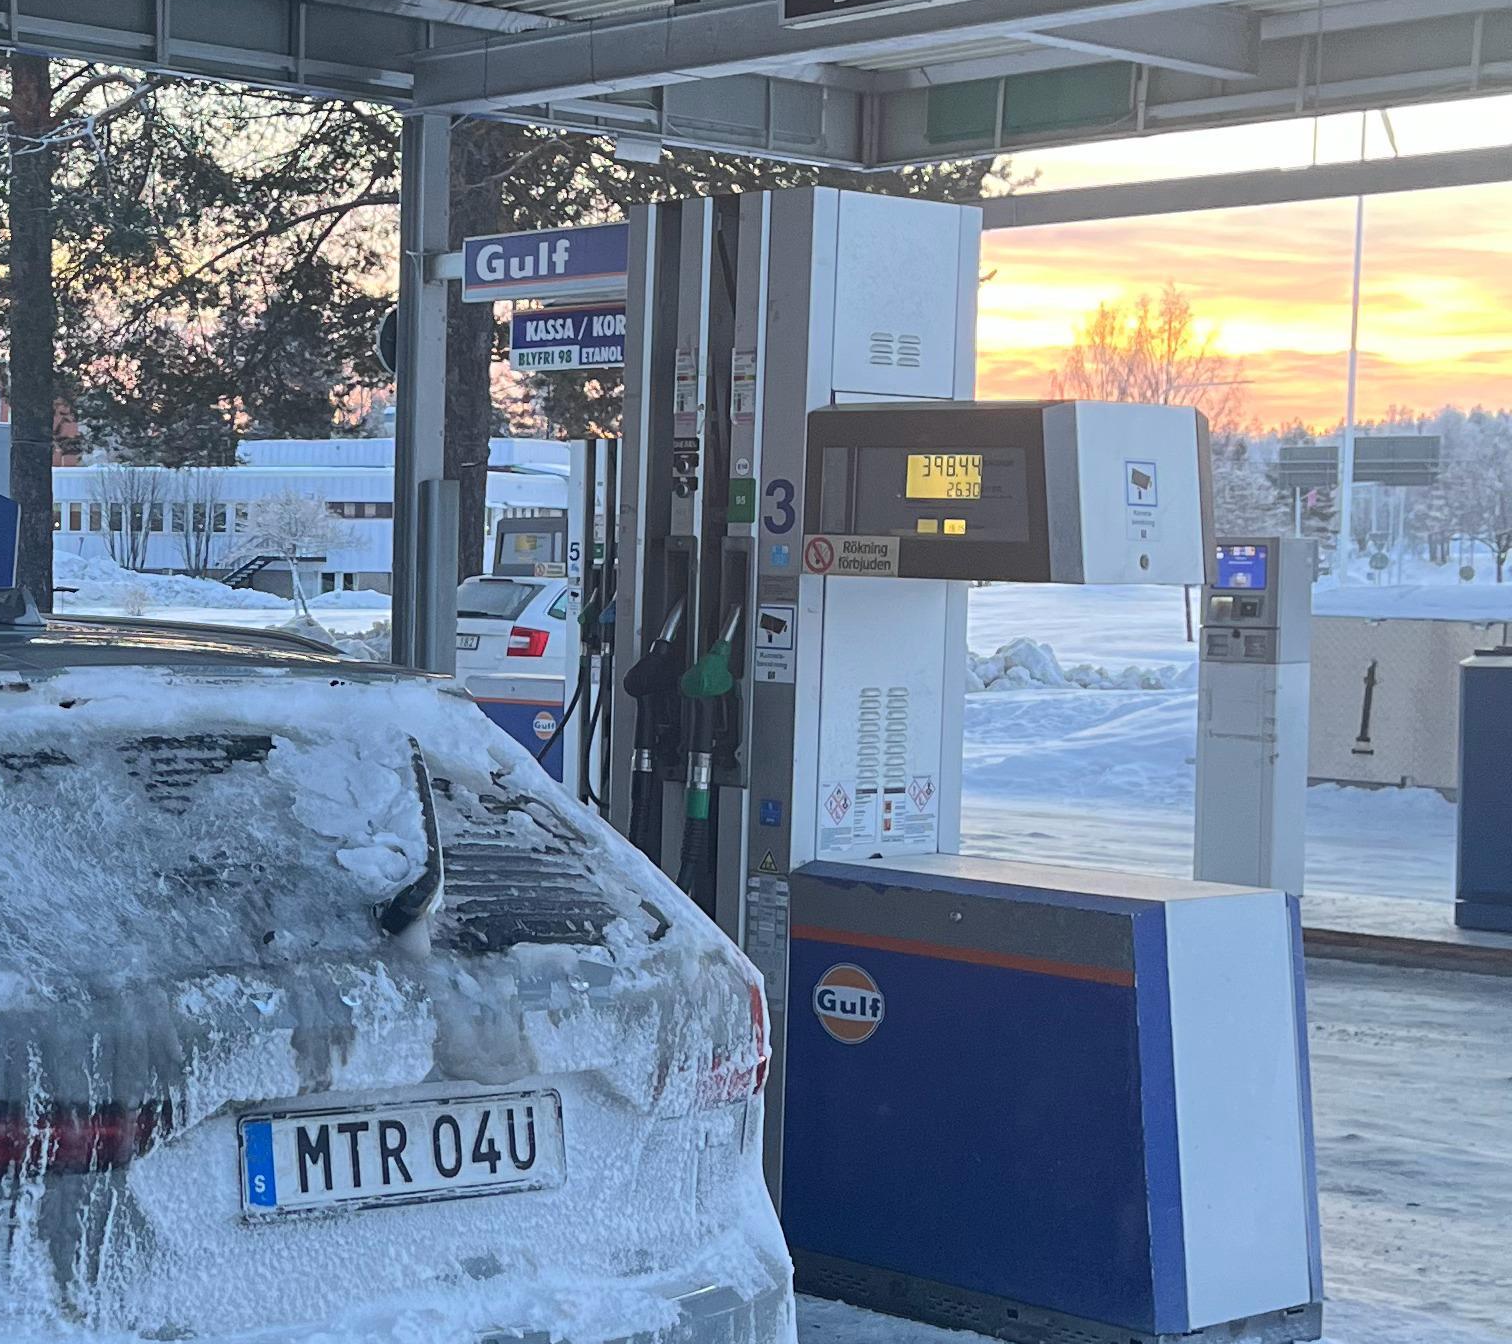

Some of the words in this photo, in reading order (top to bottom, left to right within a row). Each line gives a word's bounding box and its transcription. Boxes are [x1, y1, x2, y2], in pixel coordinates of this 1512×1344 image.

[476, 239, 570, 281] Gulf
[525, 318, 575, 342] KASSA
[592, 314, 627, 337] KOR
[518, 351, 555, 367] BLYFRI
[558, 349, 572, 364] 98
[581, 346, 623, 363] ETANOL
[922, 456, 981, 477] 398.44
[763, 478, 796, 535] 3
[569, 542, 581, 561] 5
[843, 540, 889, 557] Rökning
[838, 555, 891, 572] förbjuden
[534, 720, 555, 730] Gulf
[817, 988, 881, 1017] Gulf
[296, 1120, 413, 1193] MTR
[432, 1106, 537, 1178] 04U
[254, 1175, 266, 1194] S
